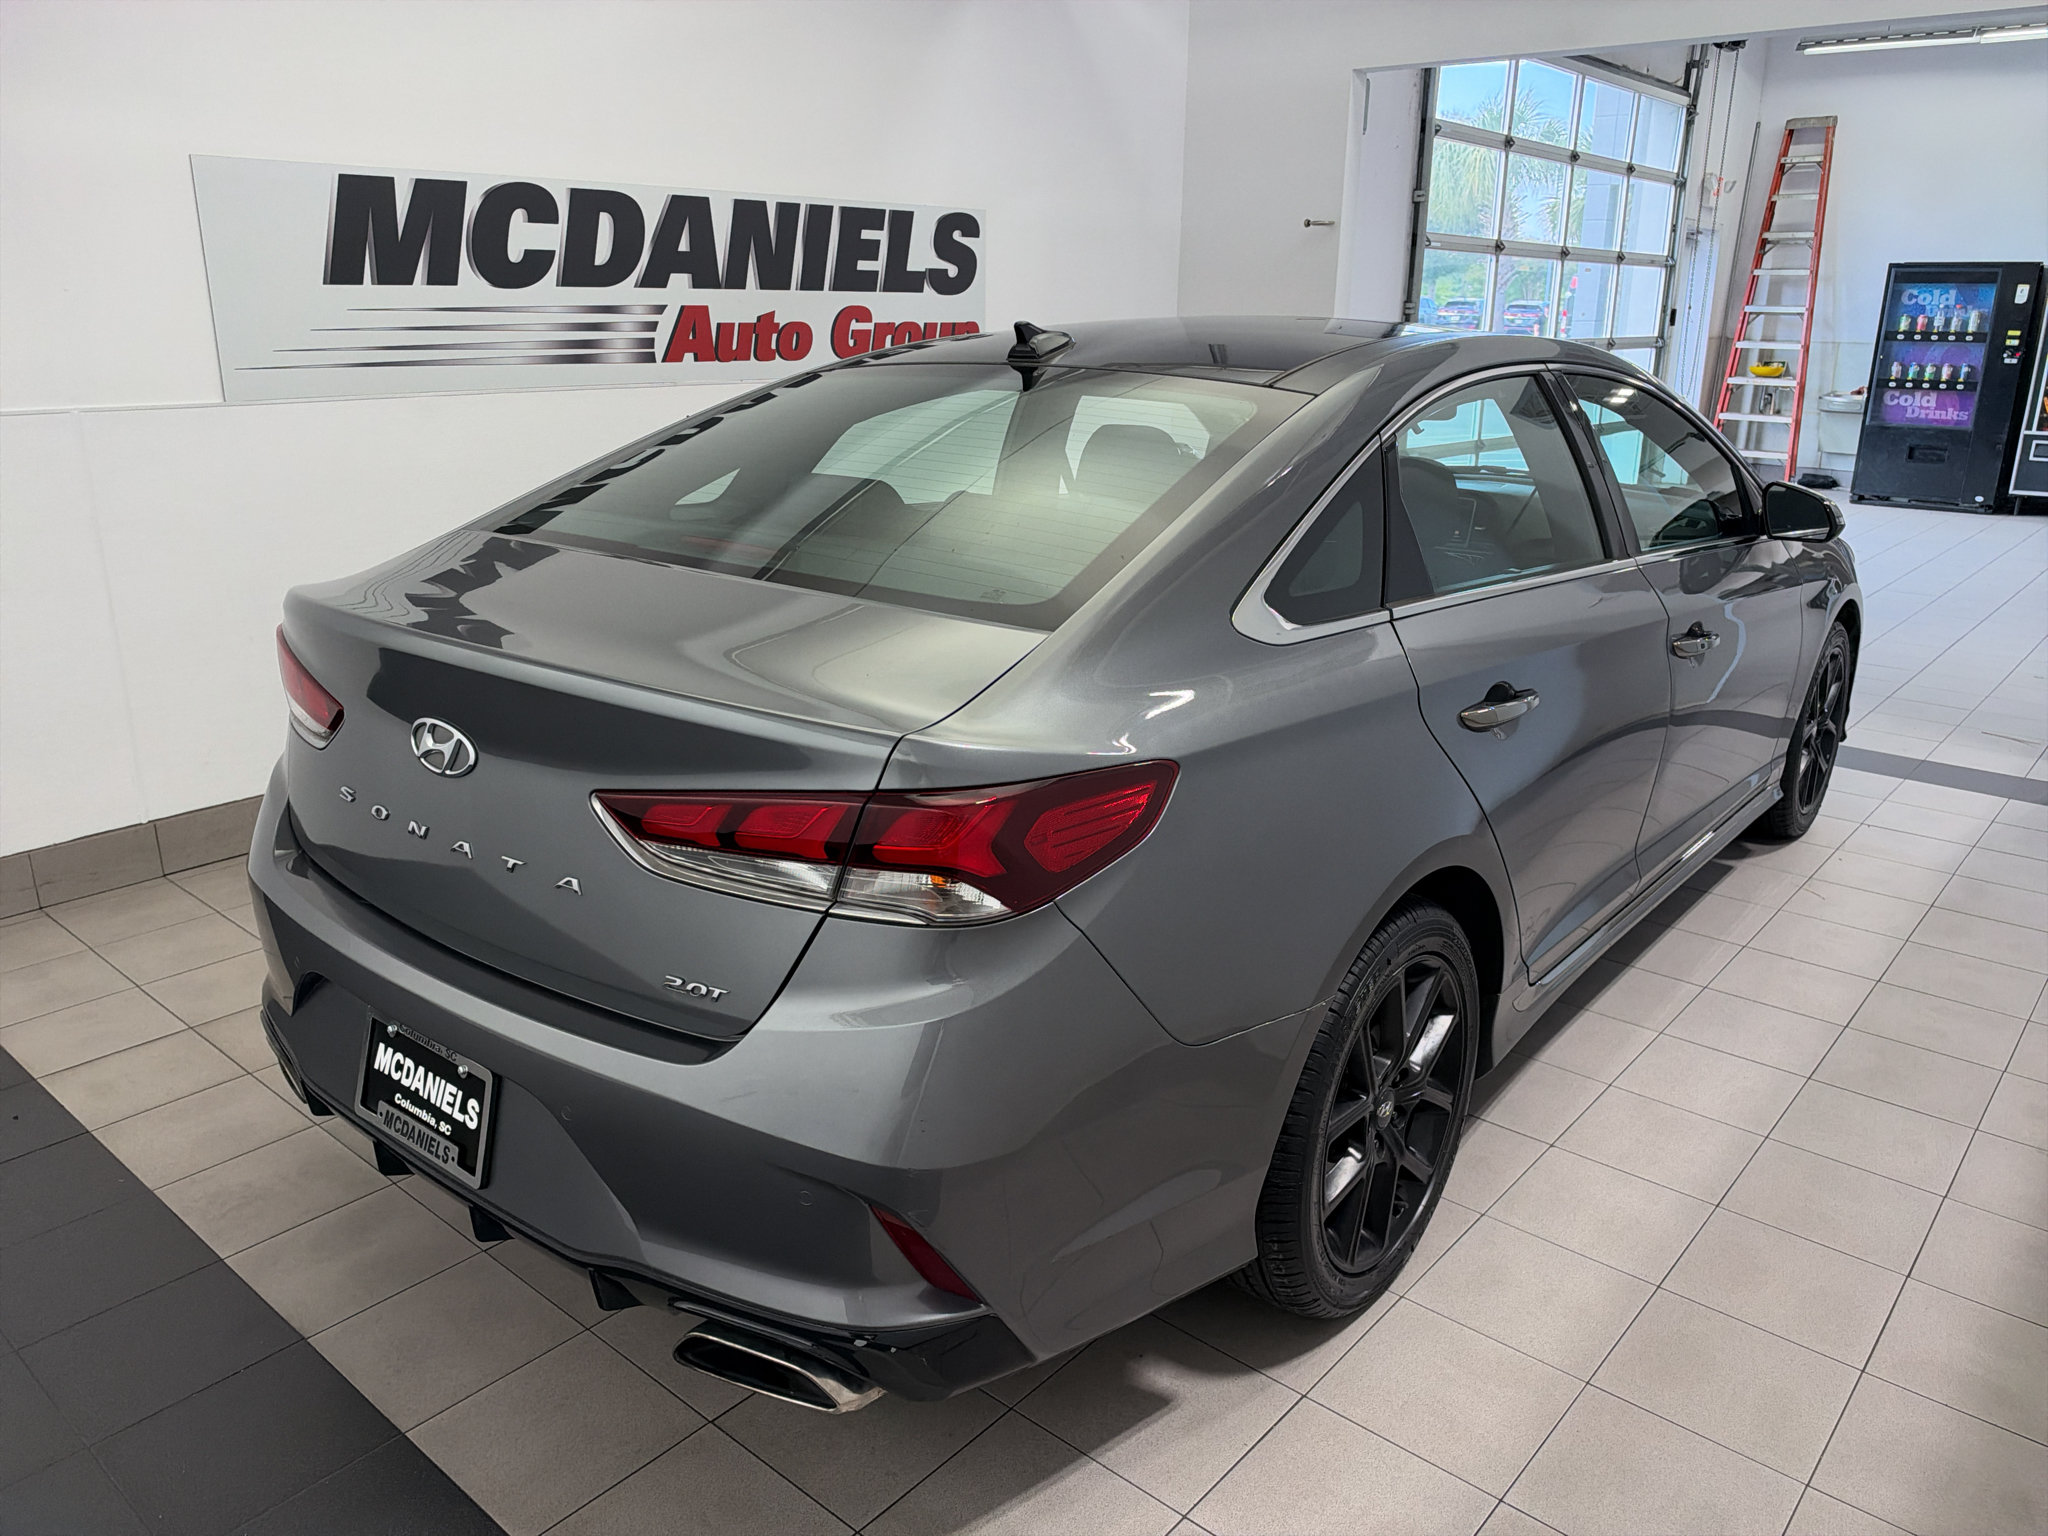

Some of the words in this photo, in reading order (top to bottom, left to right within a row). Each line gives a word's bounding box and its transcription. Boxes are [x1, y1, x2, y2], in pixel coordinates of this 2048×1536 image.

[322, 174, 979, 296] MCDANIELS
[1901, 289, 1957, 305] Cold
[661, 305, 814, 363] Auto
[1883, 390, 1937, 407] Cold
[1906, 406, 1969, 420] Drinks
[339, 786, 583, 896] SONATA
[445, 1048, 457, 1061] SC
[374, 1042, 480, 1130] MCDANIELS
[383, 1109, 450, 1164] MCDANIELS
[394, 1093, 437, 1129] Columbia,
[439, 1121, 452, 1136] SC
